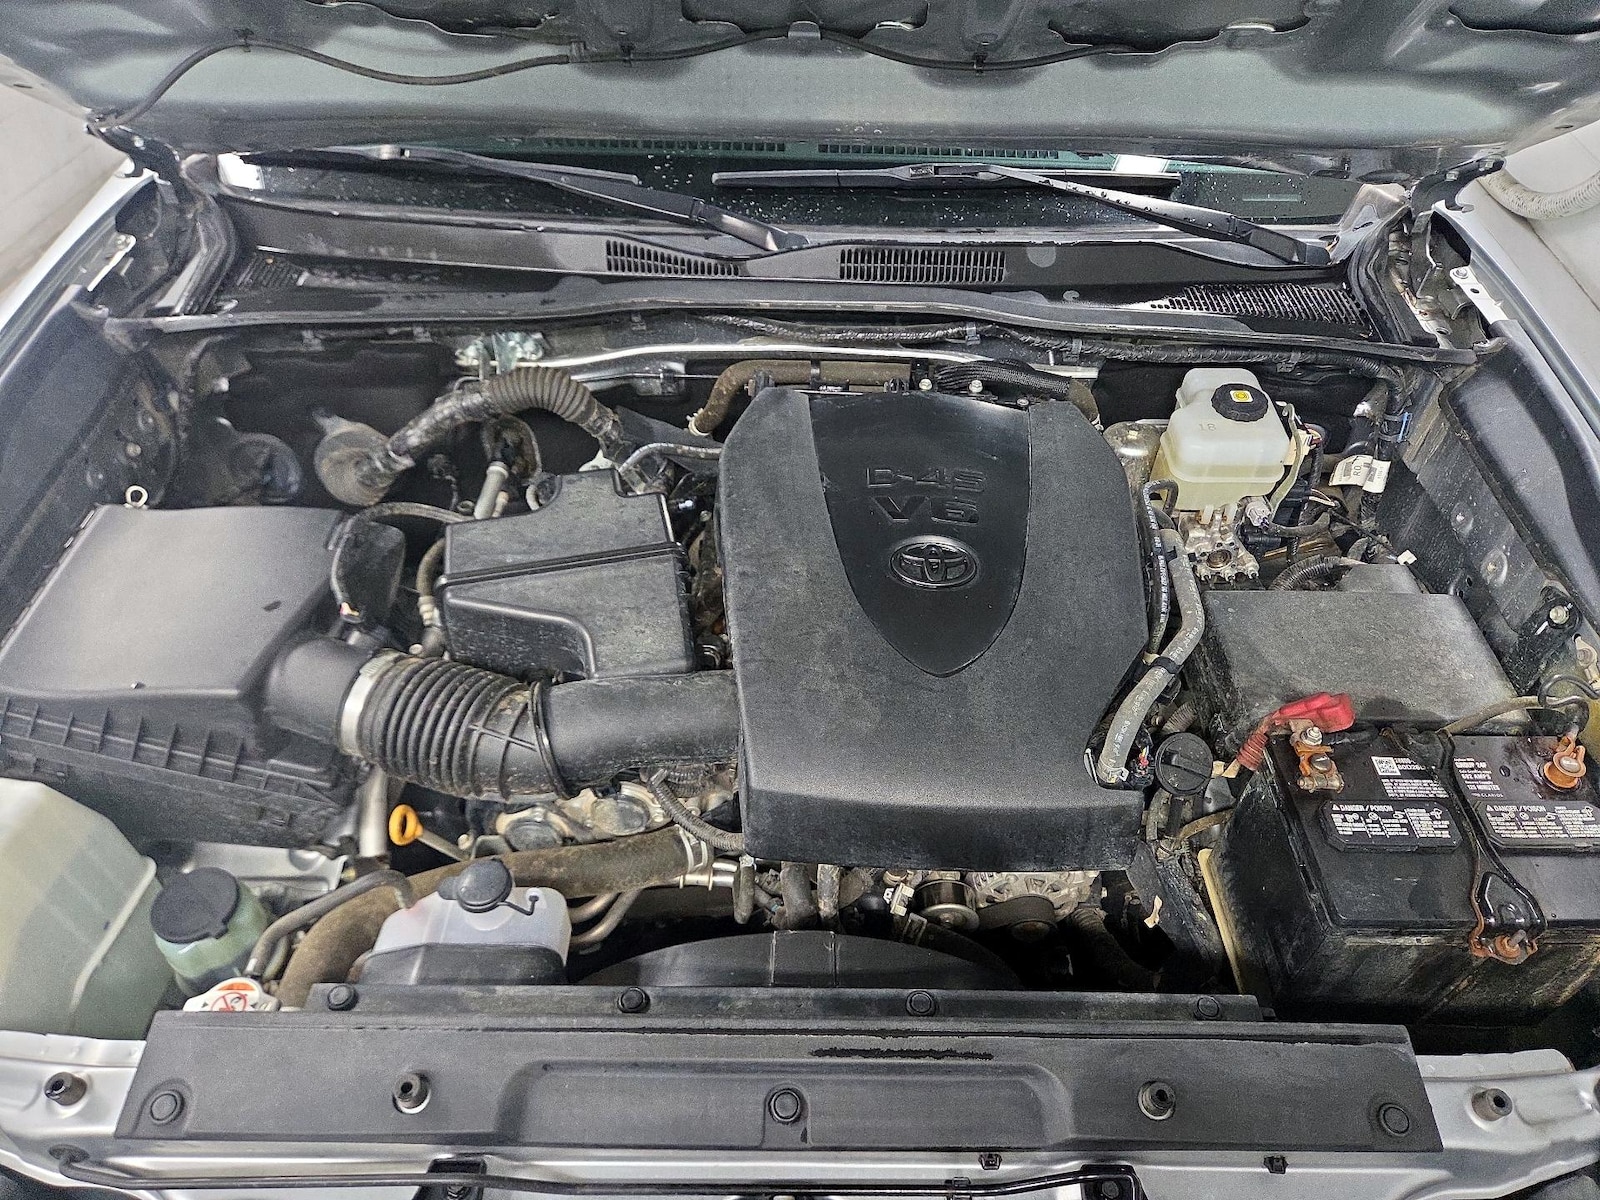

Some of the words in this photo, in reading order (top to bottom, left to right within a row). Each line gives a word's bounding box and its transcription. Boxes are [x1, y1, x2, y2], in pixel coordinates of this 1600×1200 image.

[865, 466, 987, 492] D-4S
[870, 495, 980, 526] V6
[1340, 804, 1365, 812] DANGER
[1369, 804, 1394, 812] POISON
